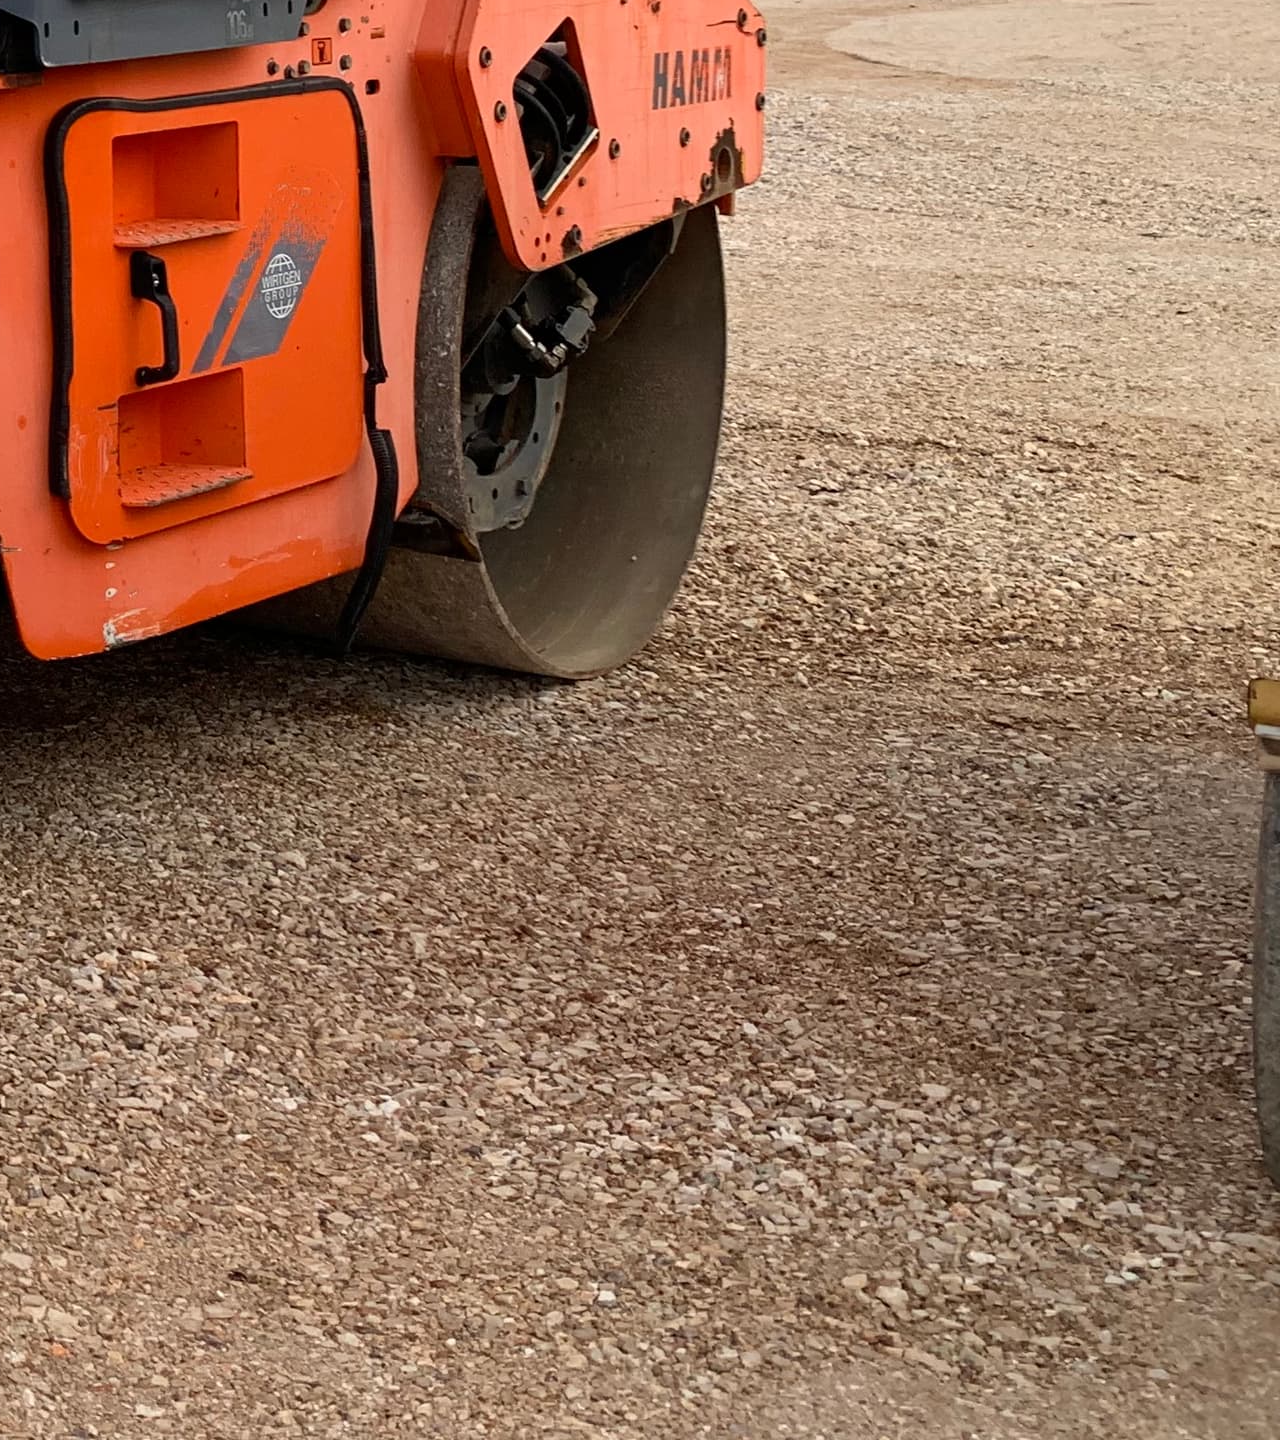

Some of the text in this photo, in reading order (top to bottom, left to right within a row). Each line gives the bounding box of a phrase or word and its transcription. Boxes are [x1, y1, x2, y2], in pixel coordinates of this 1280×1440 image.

[652, 45, 732, 110] HAMM
[262, 269, 301, 289] WIRTGEN
[264, 286, 298, 303] GROUP
